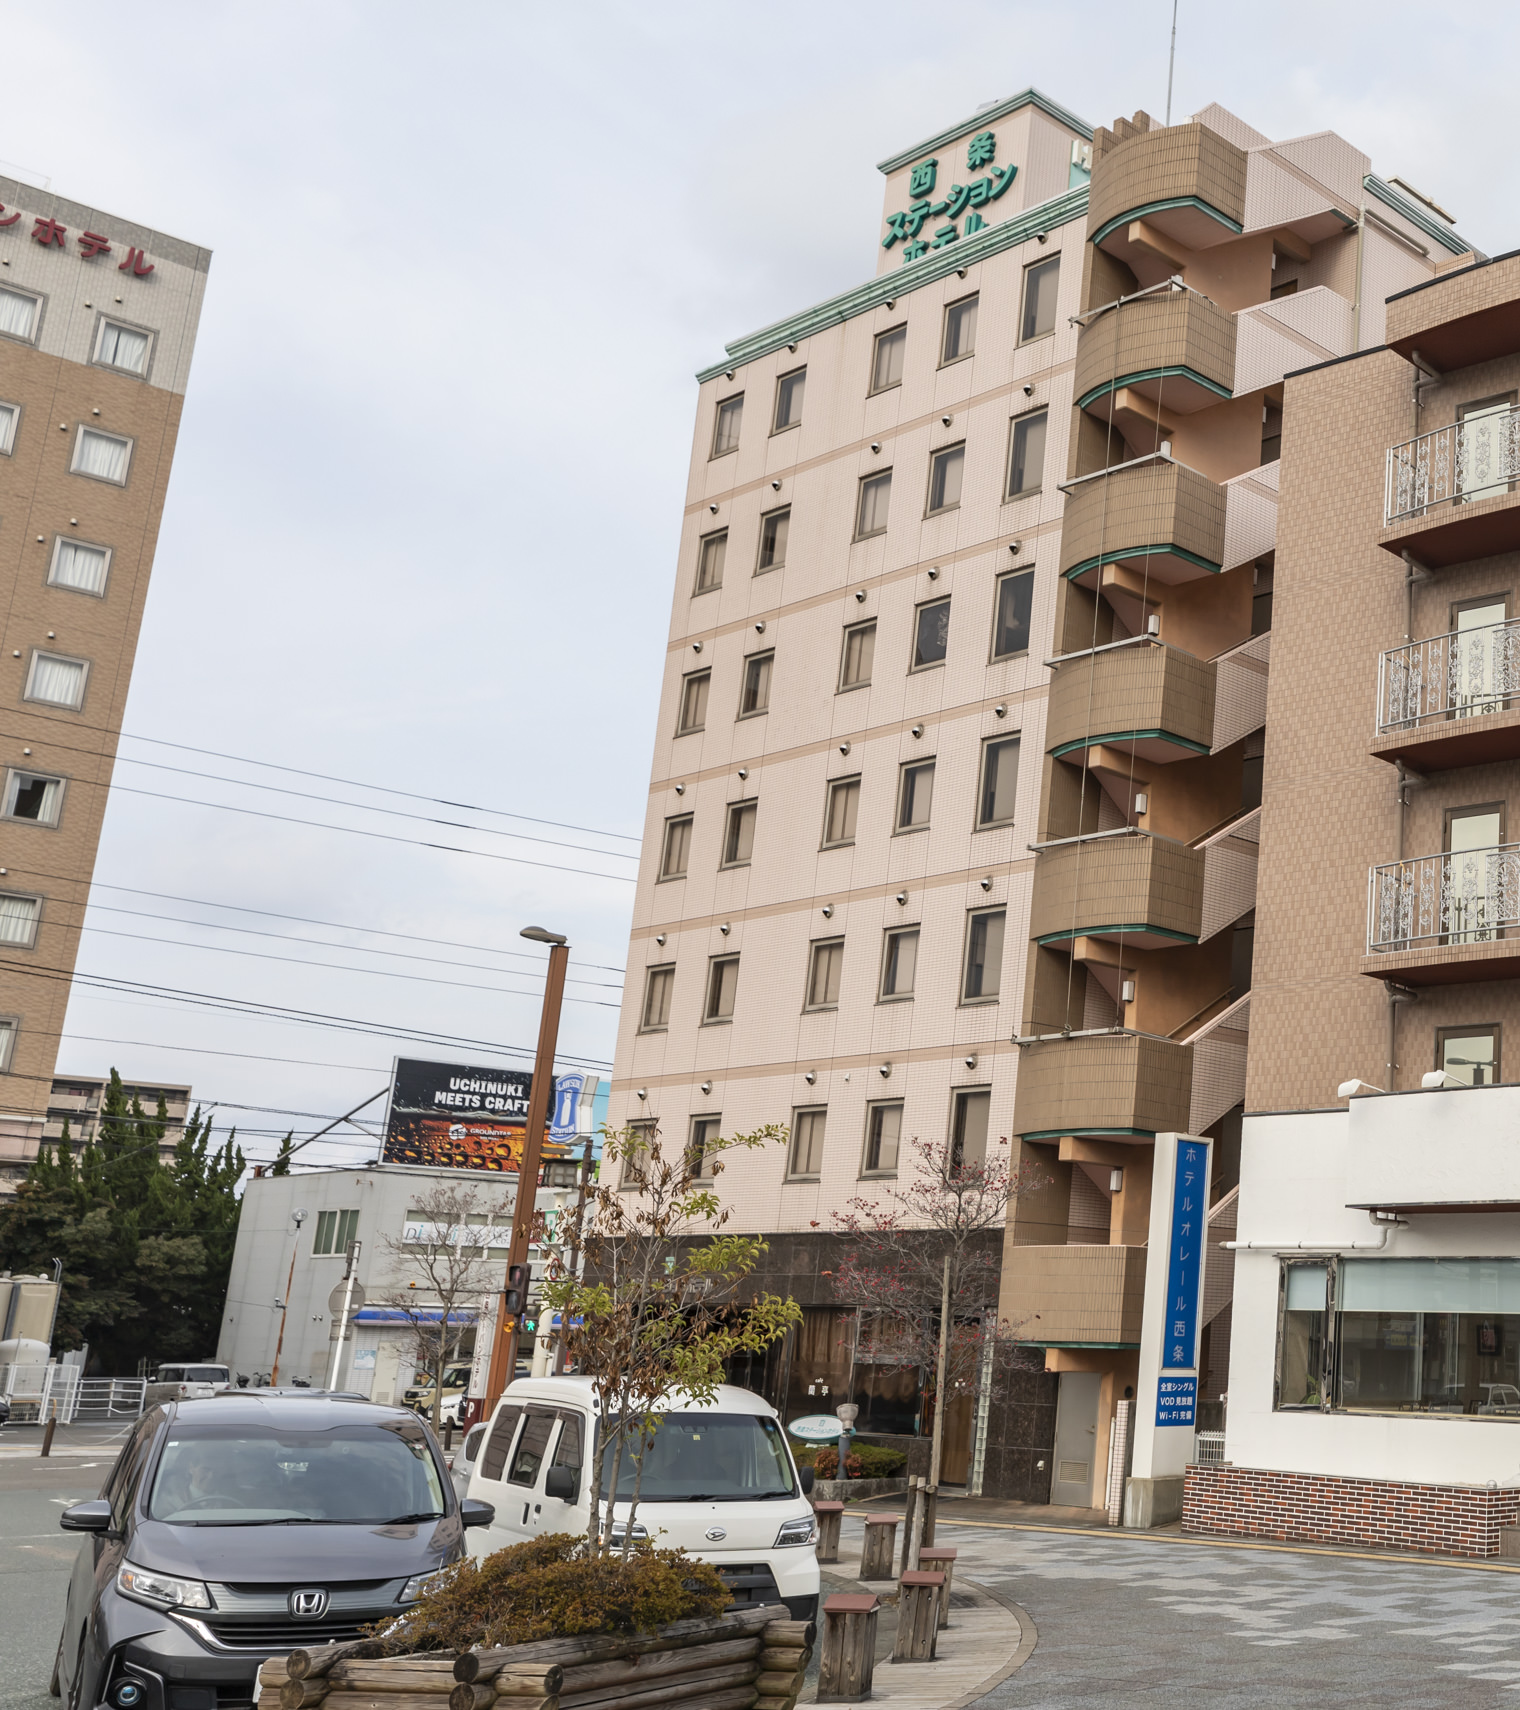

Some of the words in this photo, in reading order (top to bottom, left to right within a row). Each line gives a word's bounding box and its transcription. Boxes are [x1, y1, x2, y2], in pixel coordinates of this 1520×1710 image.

[882, 163, 1018, 249] ステーション
[450, 1077, 524, 1097] UCHINUKI
[434, 1091, 481, 1108] MEETS
[485, 1094, 530, 1113] CRAFT
[1172, 1147, 1197, 1362] ホテルオレール西条
[467, 1401, 475, 1417] P
[1160, 1396, 1175, 1406] VOD
